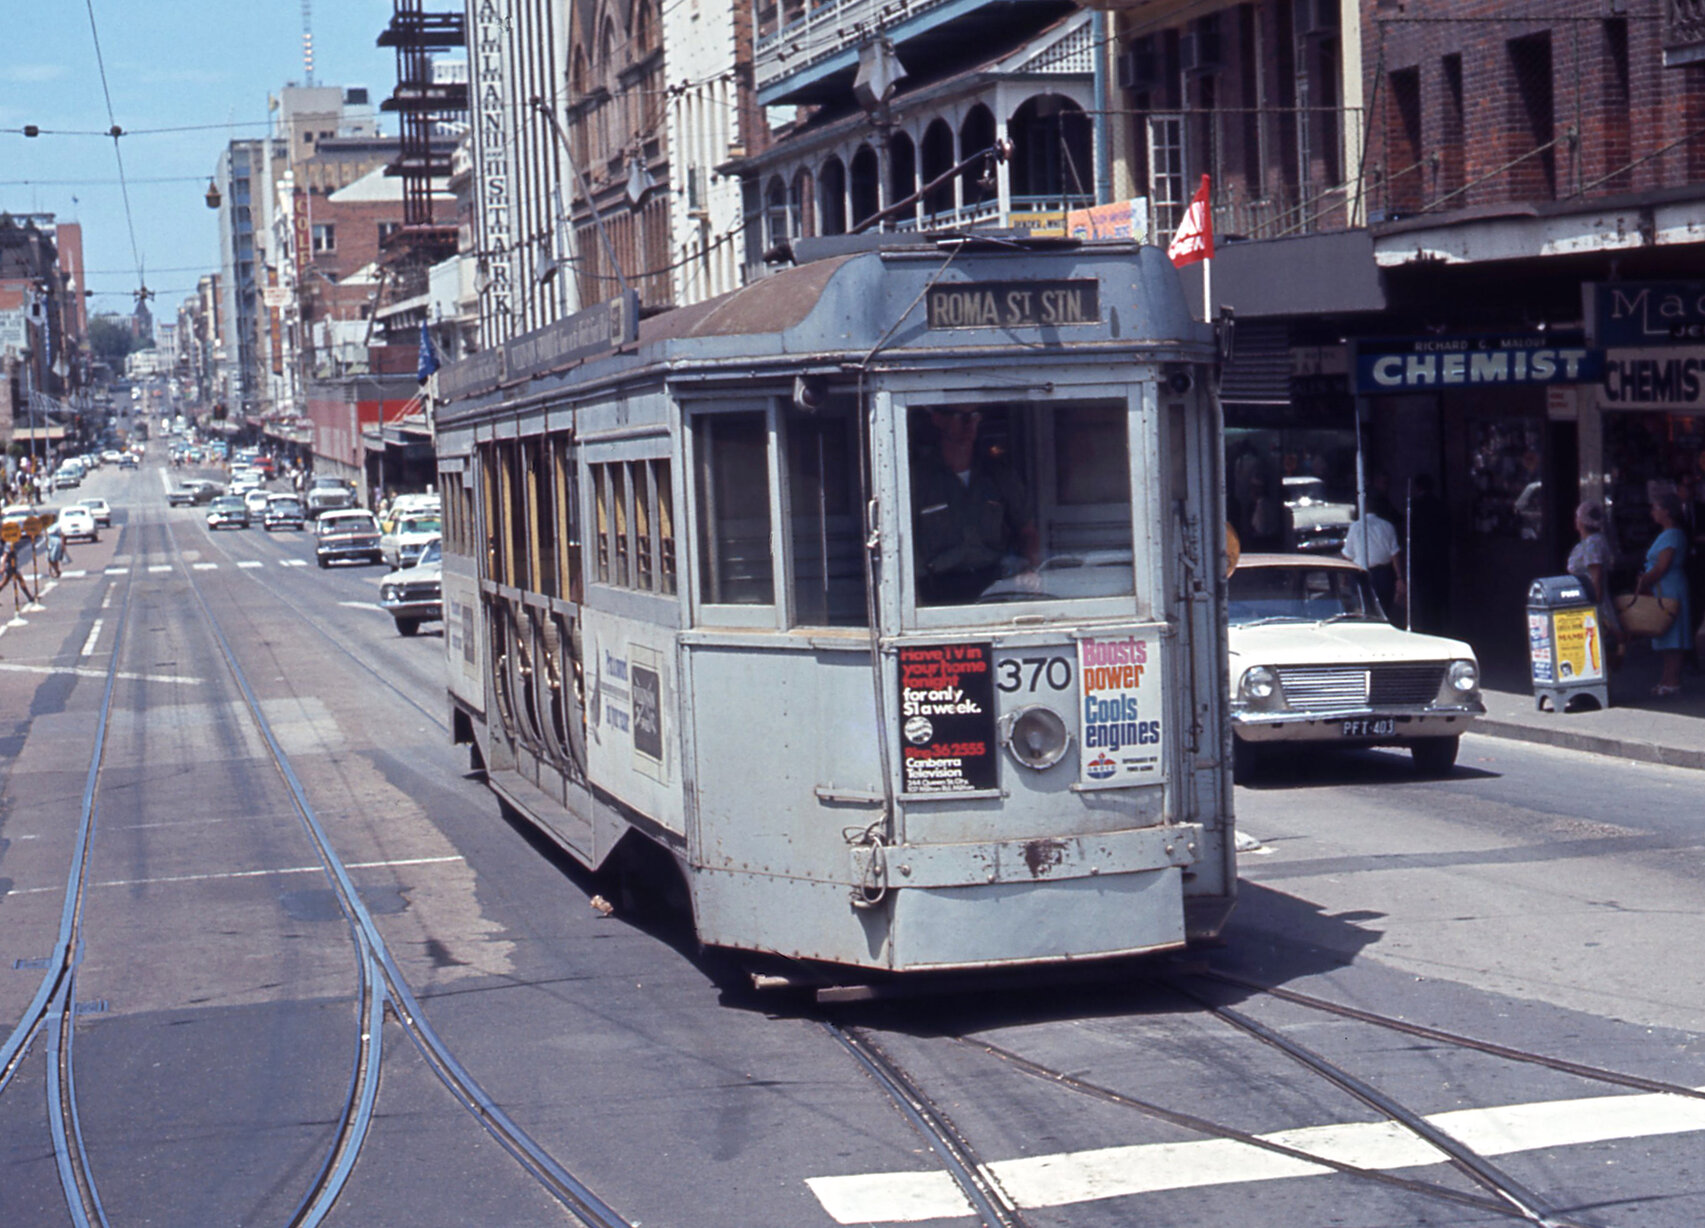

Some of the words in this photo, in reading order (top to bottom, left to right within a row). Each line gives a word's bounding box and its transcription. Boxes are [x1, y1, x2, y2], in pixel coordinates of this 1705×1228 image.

[480, 0, 501, 130] ALLAN
[488, 178, 511, 314] STARK
[932, 291, 999, 325] ROMA
[1006, 291, 1032, 323] ST
[1415, 340, 1469, 351] RICHARD
[1373, 349, 1588, 387] CHEMIST
[1604, 358, 1705, 403] CHEMIS
[900, 648, 942, 661] Have
[944, 646, 964, 660] TV
[966, 645, 982, 659] in
[1081, 636, 1147, 667] Boosts
[902, 663, 939, 677] your
[940, 659, 987, 673] home
[902, 673, 959, 690] tonight
[996, 656, 1072, 693] 370
[1083, 664, 1144, 697] power
[903, 687, 926, 702] for
[928, 686, 963, 703] only
[920, 704, 932, 714] a
[1085, 693, 1138, 724] Cools
[931, 743, 950, 756] 36
[951, 742, 986, 756] 2555
[1086, 721, 1160, 752] engines
[905, 757, 962, 768] Canberra
[906, 767, 963, 779] Television
